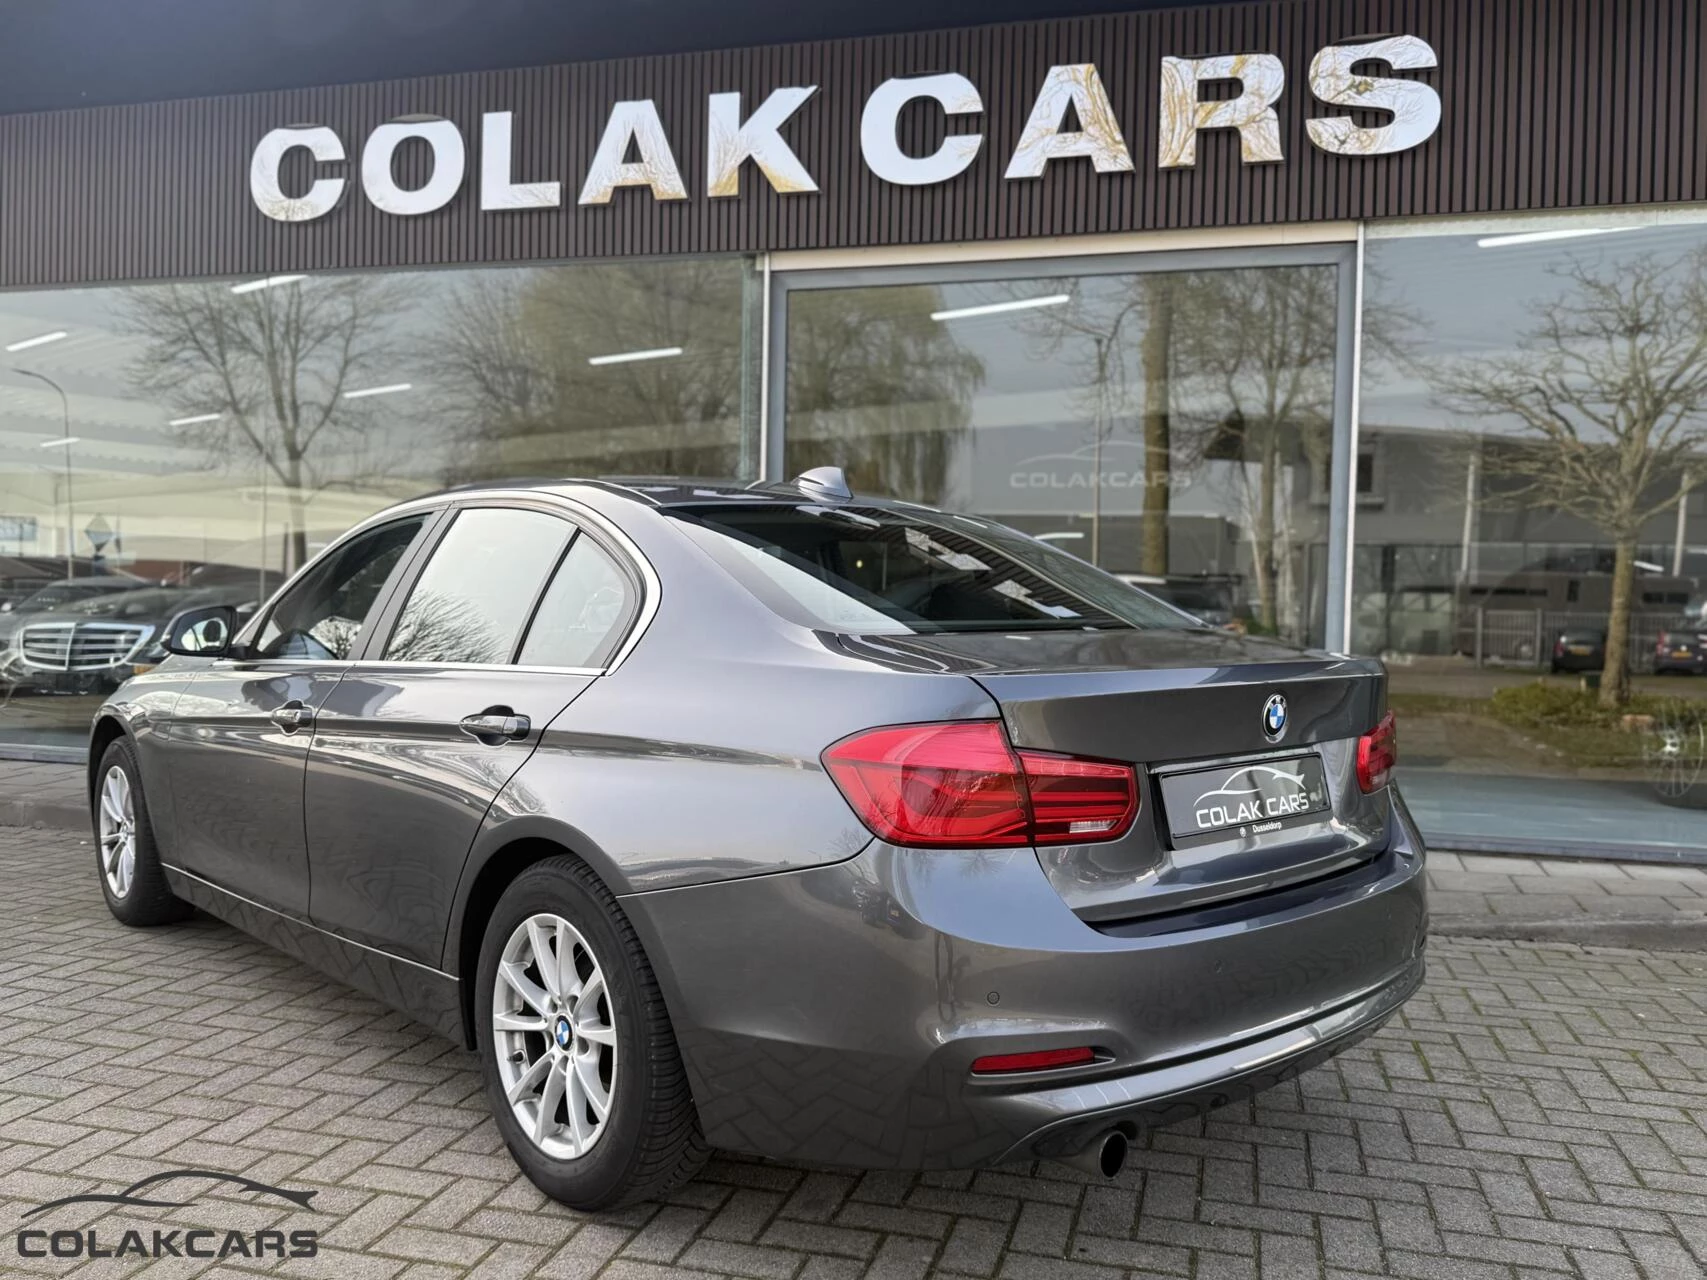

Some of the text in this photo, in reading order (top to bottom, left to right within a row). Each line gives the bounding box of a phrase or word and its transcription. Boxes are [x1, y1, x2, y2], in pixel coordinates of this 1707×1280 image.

[249, 34, 1443, 222] COLAK CARS
[1009, 471, 1192, 488] COLAKCARS
[1196, 793, 1309, 828] COLAK CARS
